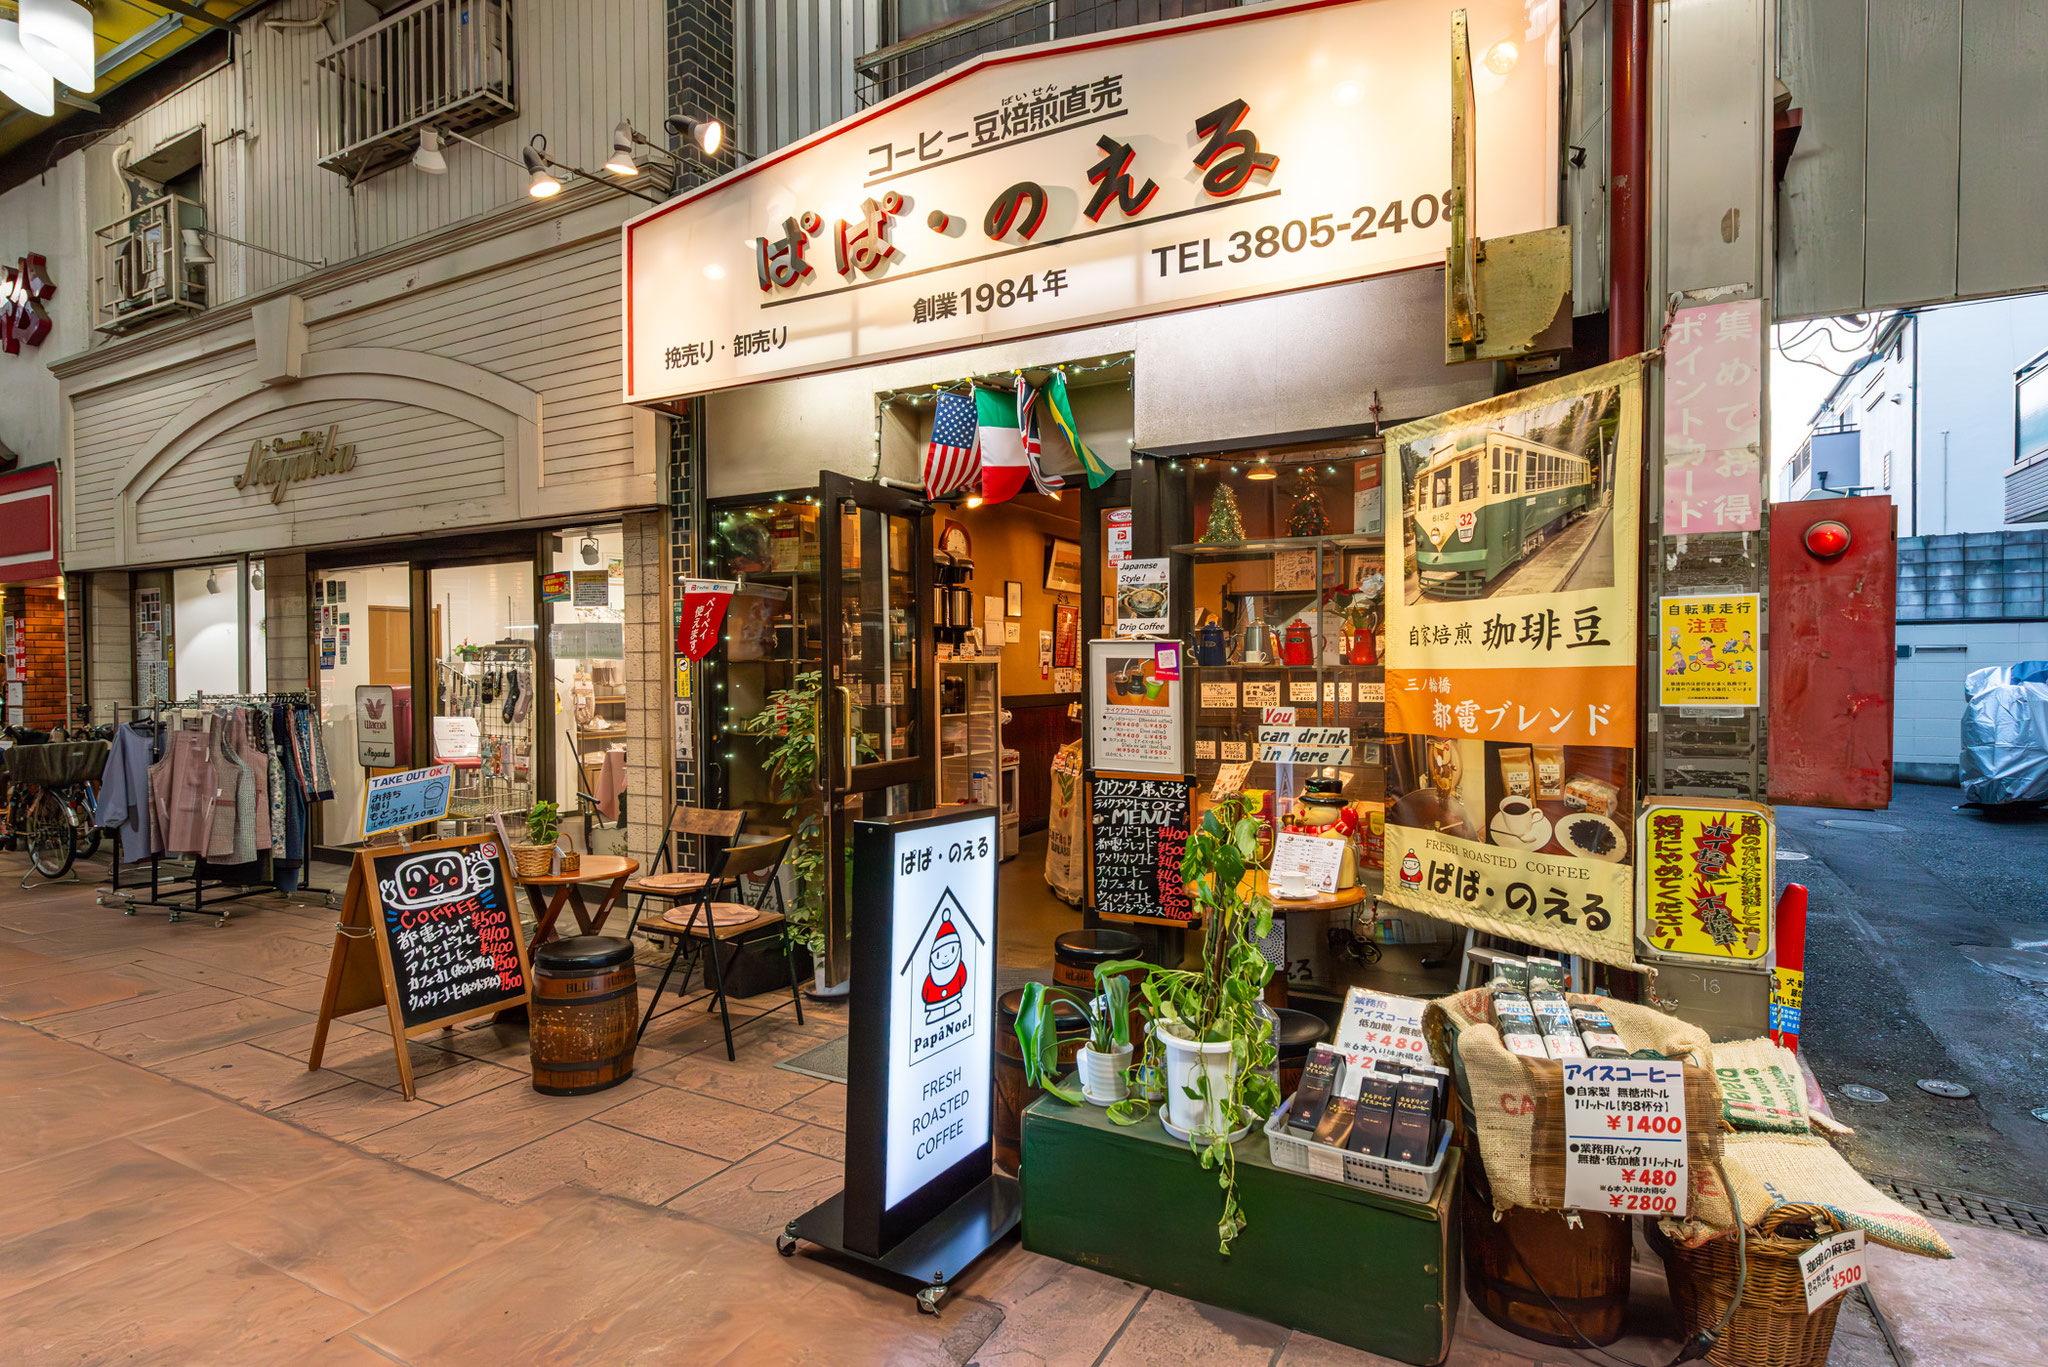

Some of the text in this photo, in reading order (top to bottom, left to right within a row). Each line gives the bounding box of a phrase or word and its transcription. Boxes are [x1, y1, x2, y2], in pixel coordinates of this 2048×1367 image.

[1001, 83, 1058, 106] ばいせん
[868, 75, 1123, 177] コーヒー豆焙煎直売
[755, 98, 1281, 294] ぱぱ・のえる
[913, 269, 1068, 324] 創業1984年
[1670, 312, 1708, 528] ポイントカード
[1713, 310, 1753, 526] 集めてお得
[1459, 512, 1473, 527] 32
[1120, 562, 1158, 572] Japanese
[1669, 602, 1751, 616] 自転車走行
[1119, 622, 1165, 632] Drip Coffee
[1408, 606, 1611, 651] 自家焙煎 珈琲豆
[1687, 618, 1728, 634] 注意
[1404, 676, 1452, 694] 三ノ輪橋
[364, 720, 387, 730] Wacoal
[1264, 708, 1293, 723] You
[1432, 697, 1611, 737] 都電ブレンド
[1260, 729, 1348, 744] can drink
[1262, 746, 1280, 761] in
[1289, 747, 1328, 762] here
[372, 774, 403, 788] TAKE
[406, 770, 427, 782] OUT
[371, 790, 402, 803] お持ち
[370, 801, 390, 813] 帰り
[1111, 809, 1171, 827] MENU
[1159, 825, 1188, 840] ¥400
[1096, 837, 1157, 853] 都電ブレンド
[900, 836, 990, 876] ぱぱ・のえる
[1425, 838, 1590, 881] FRESH ROASTED COFFEE
[1096, 865, 1151, 878] アイスコーヒー
[1097, 876, 1149, 891] カフェオレ
[1158, 892, 1189, 907] ¥500
[1427, 860, 1612, 932] ぱぱ・のえる
[400, 897, 480, 929] COFFEE
[1099, 901, 1192, 920] オレンジジュース ¥400
[397, 911, 507, 950] 都電ブレンド ¥500
[403, 926, 510, 964] ブレンドコーヒー ¥400
[405, 939, 514, 976] アイスコーヒー ¥400
[492, 953, 518, 972] ¥500
[499, 970, 522, 991] ¥500
[1354, 996, 1387, 1009] 業務用
[1353, 1007, 1418, 1026] アイスコーヒ
[914, 1013, 972, 1053] PapáNoel
[1365, 1031, 1423, 1053] ¥480
[922, 1066, 963, 1101] FRESH
[1565, 1065, 1681, 1083] アイスコーヒー
[1577, 1086, 1670, 1099] 自家製 無糖ボトル
[912, 1089, 970, 1136] ROASTED
[1606, 1115, 1682, 1134] ¥1400
[916, 1118, 964, 1161] COFFEE
[1580, 1143, 1642, 1156] 業務用パック
[1622, 1169, 1677, 1186] ¥480
[1609, 1194, 1677, 1212] ¥2800
[1832, 1264, 1861, 1290] ¥500
